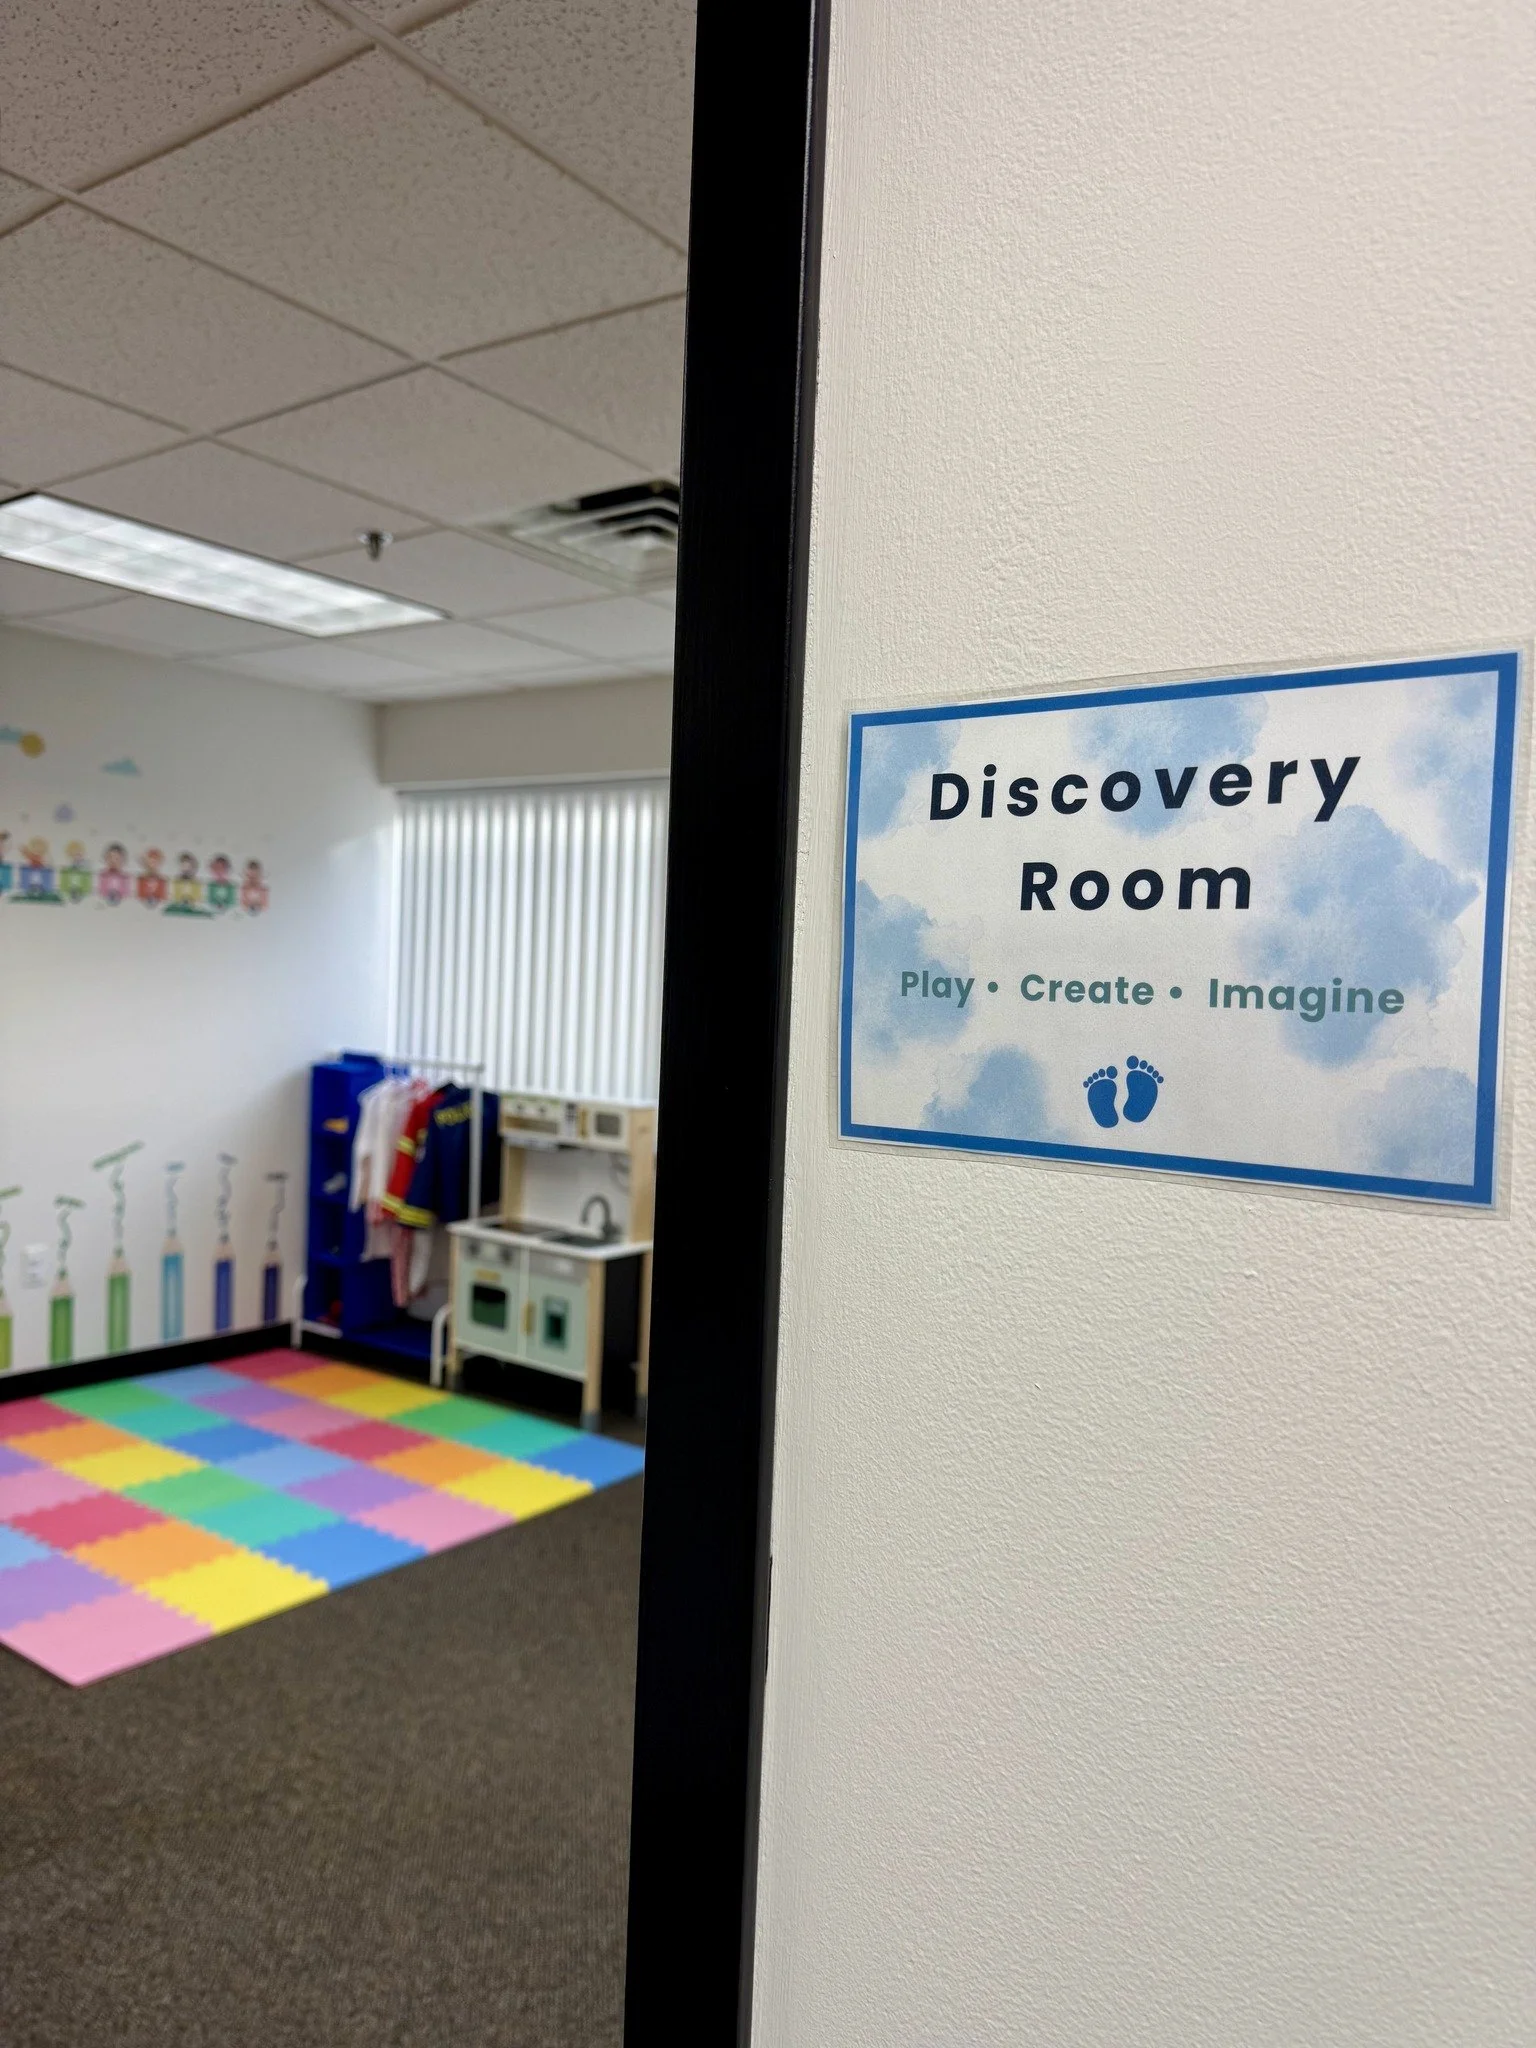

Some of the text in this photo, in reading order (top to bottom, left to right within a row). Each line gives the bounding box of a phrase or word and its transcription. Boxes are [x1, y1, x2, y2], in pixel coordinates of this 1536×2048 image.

[929, 756, 1361, 823] Discovery
[1020, 861, 1252, 911] Room
[899, 970, 1406, 1023] Play Create Imagine
